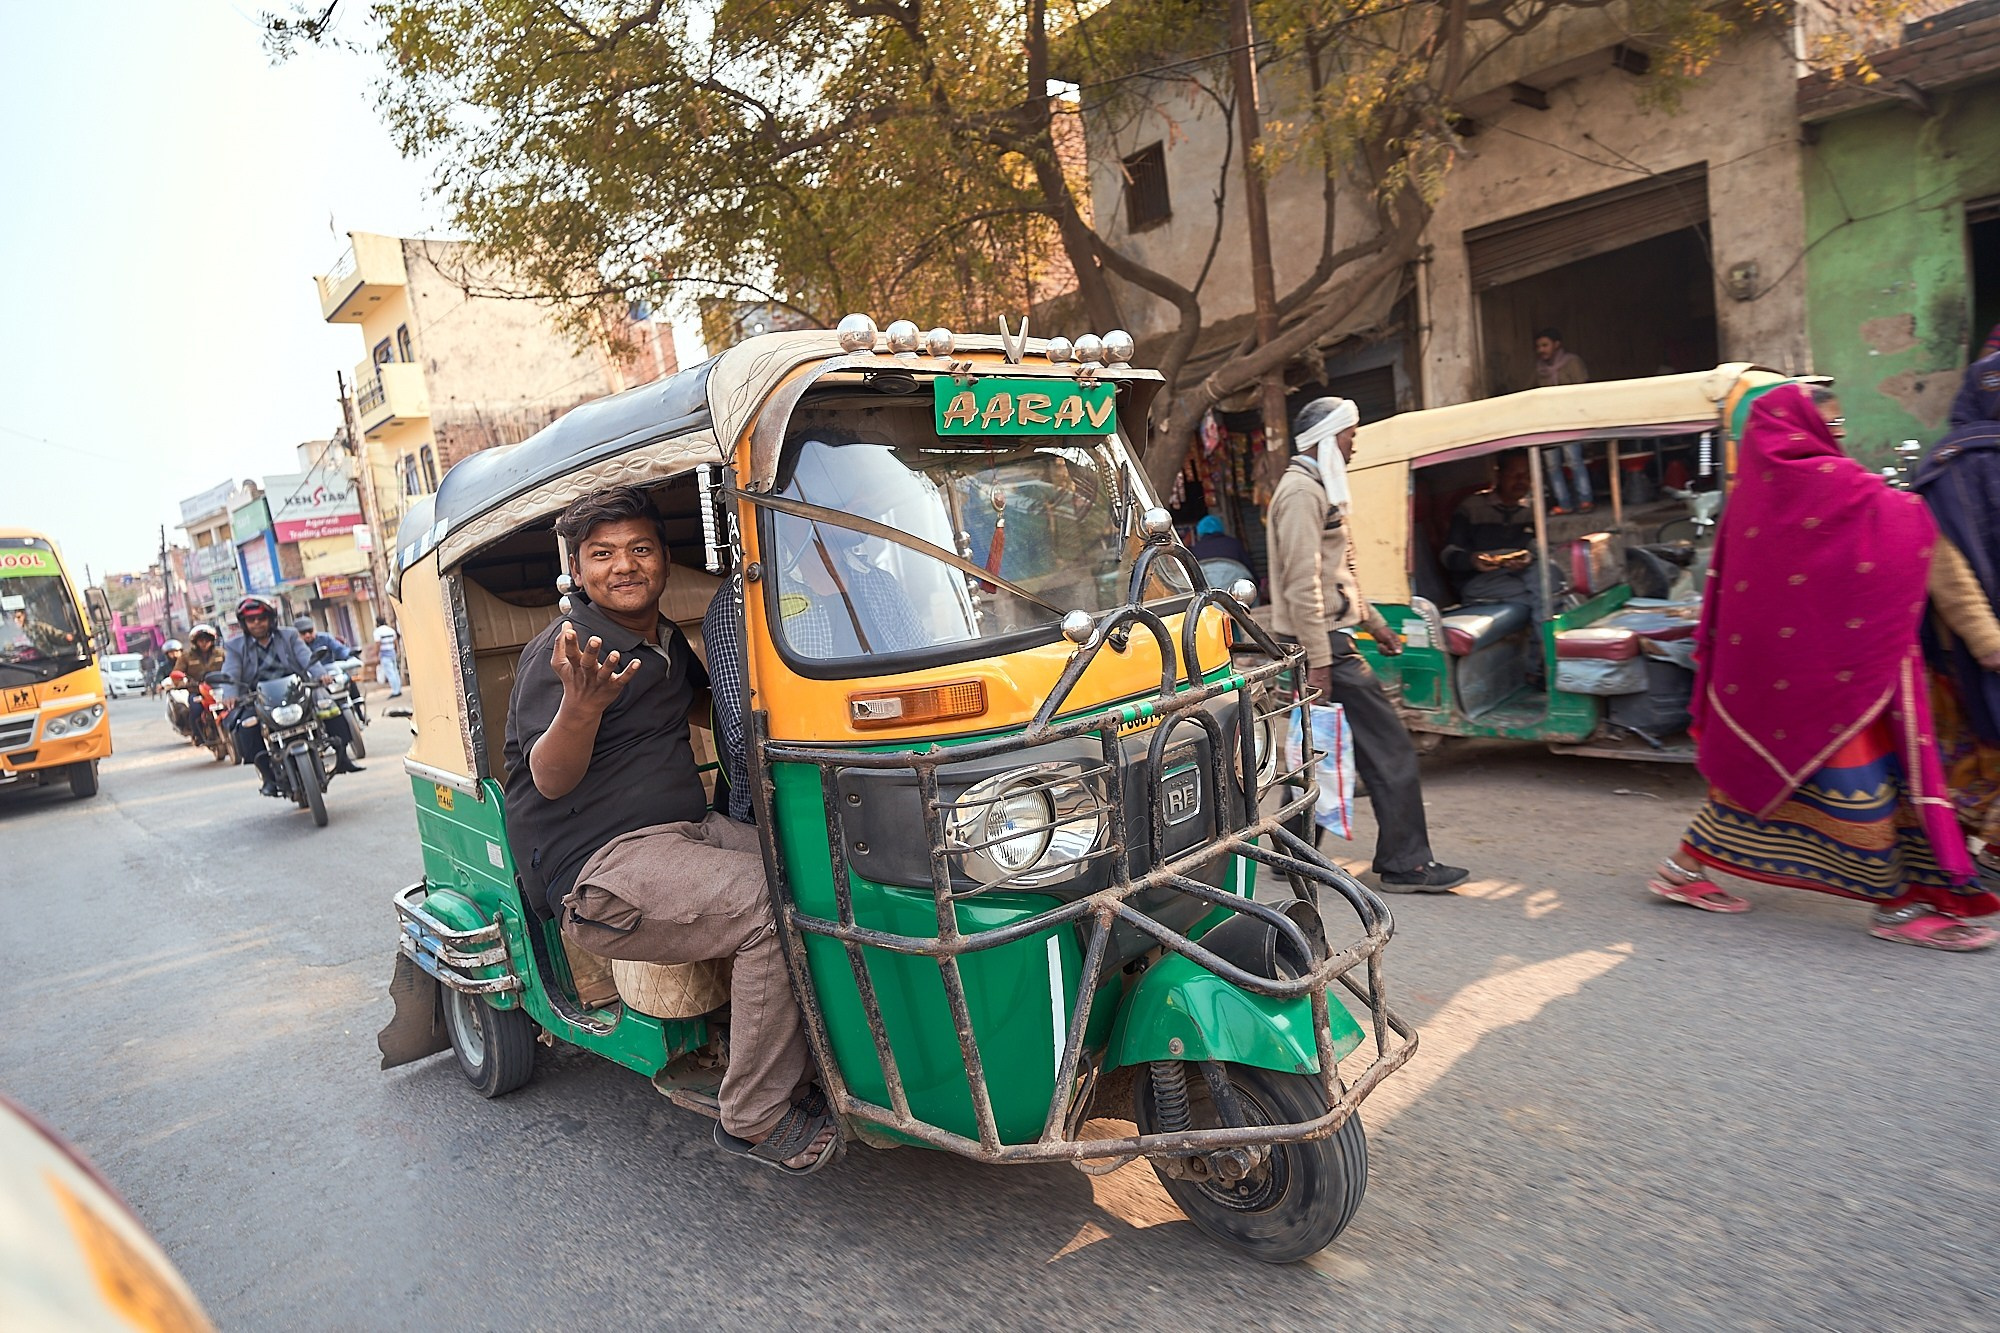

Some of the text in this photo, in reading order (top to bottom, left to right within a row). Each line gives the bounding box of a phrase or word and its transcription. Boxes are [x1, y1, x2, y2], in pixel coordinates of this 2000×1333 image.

[942, 391, 1113, 430] AARAV
[289, 529, 321, 540] Trading
[1168, 784, 1195, 814] RE
